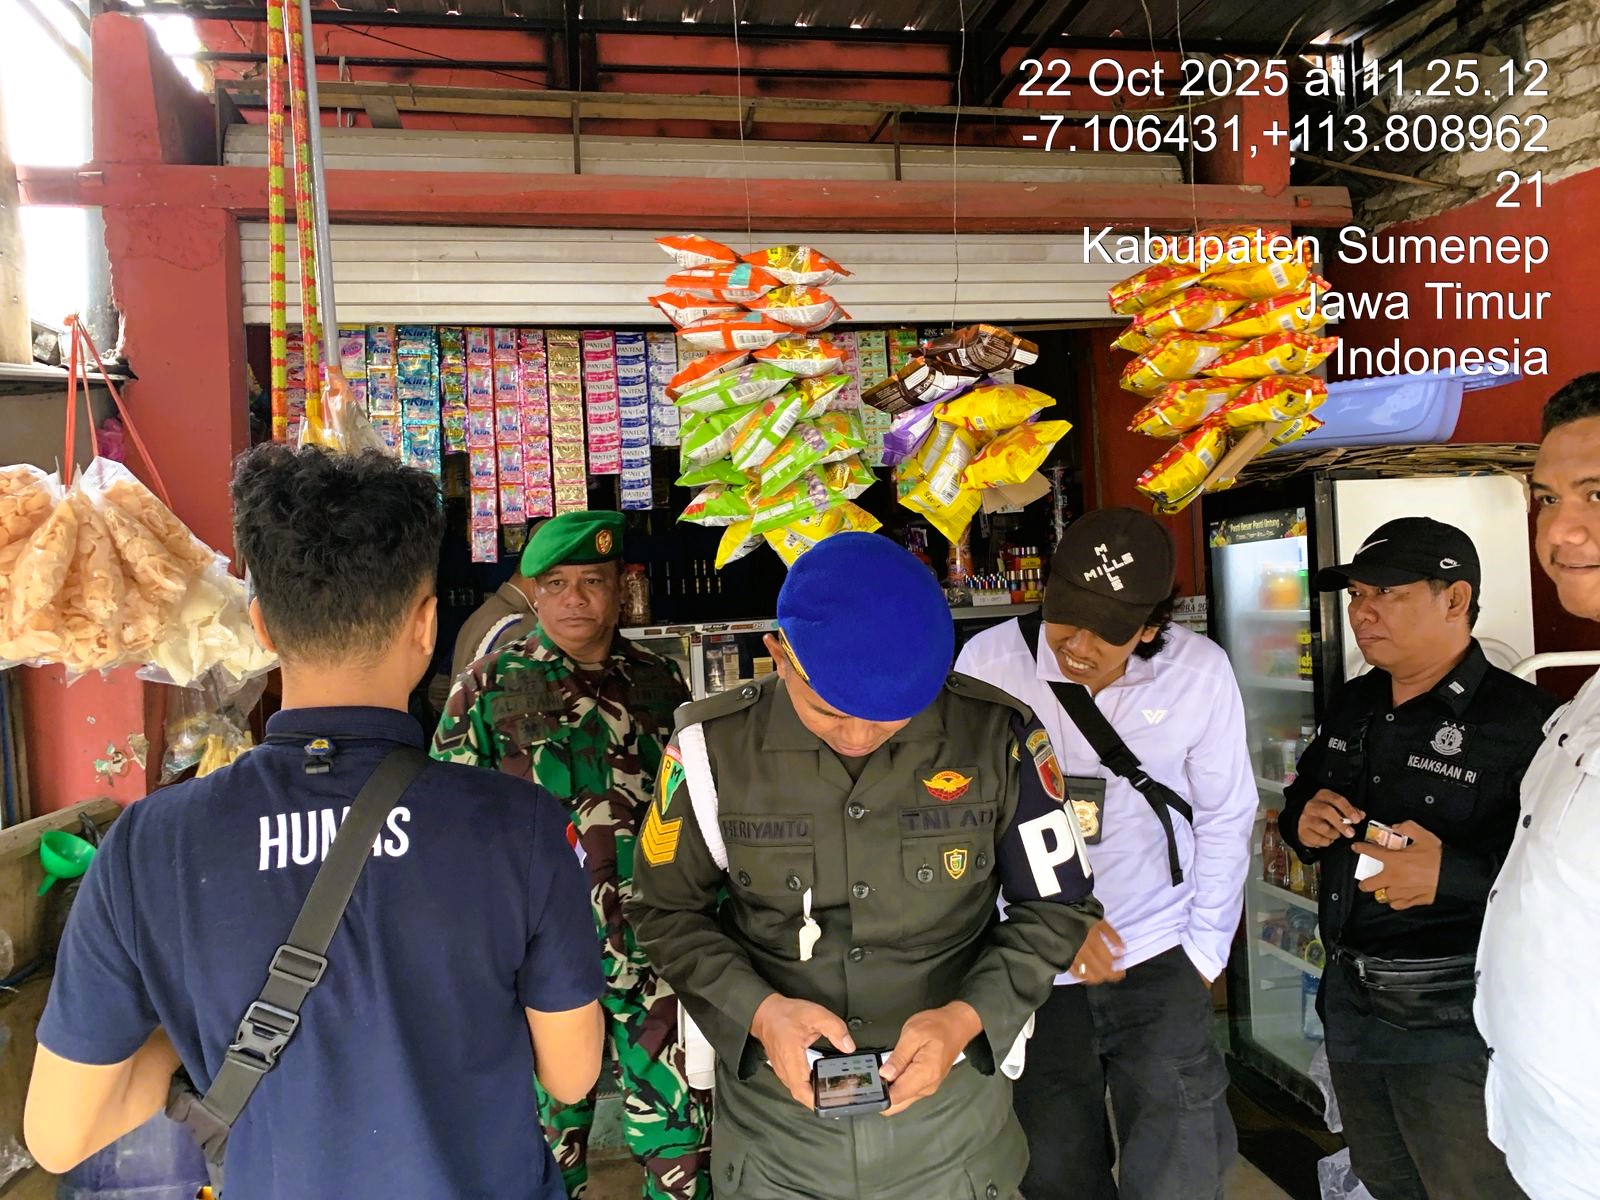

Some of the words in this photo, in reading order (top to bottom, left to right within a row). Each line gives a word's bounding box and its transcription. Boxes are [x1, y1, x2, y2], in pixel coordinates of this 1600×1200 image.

[1083, 552, 1134, 582] MILLS
[664, 759, 683, 783] PM
[1407, 754, 1462, 780] KEJAKSAAN
[1465, 770, 1477, 784] RI
[902, 808, 951, 831] TNI
[259, 806, 411, 871] HUMS
[1018, 799, 1092, 897] P
